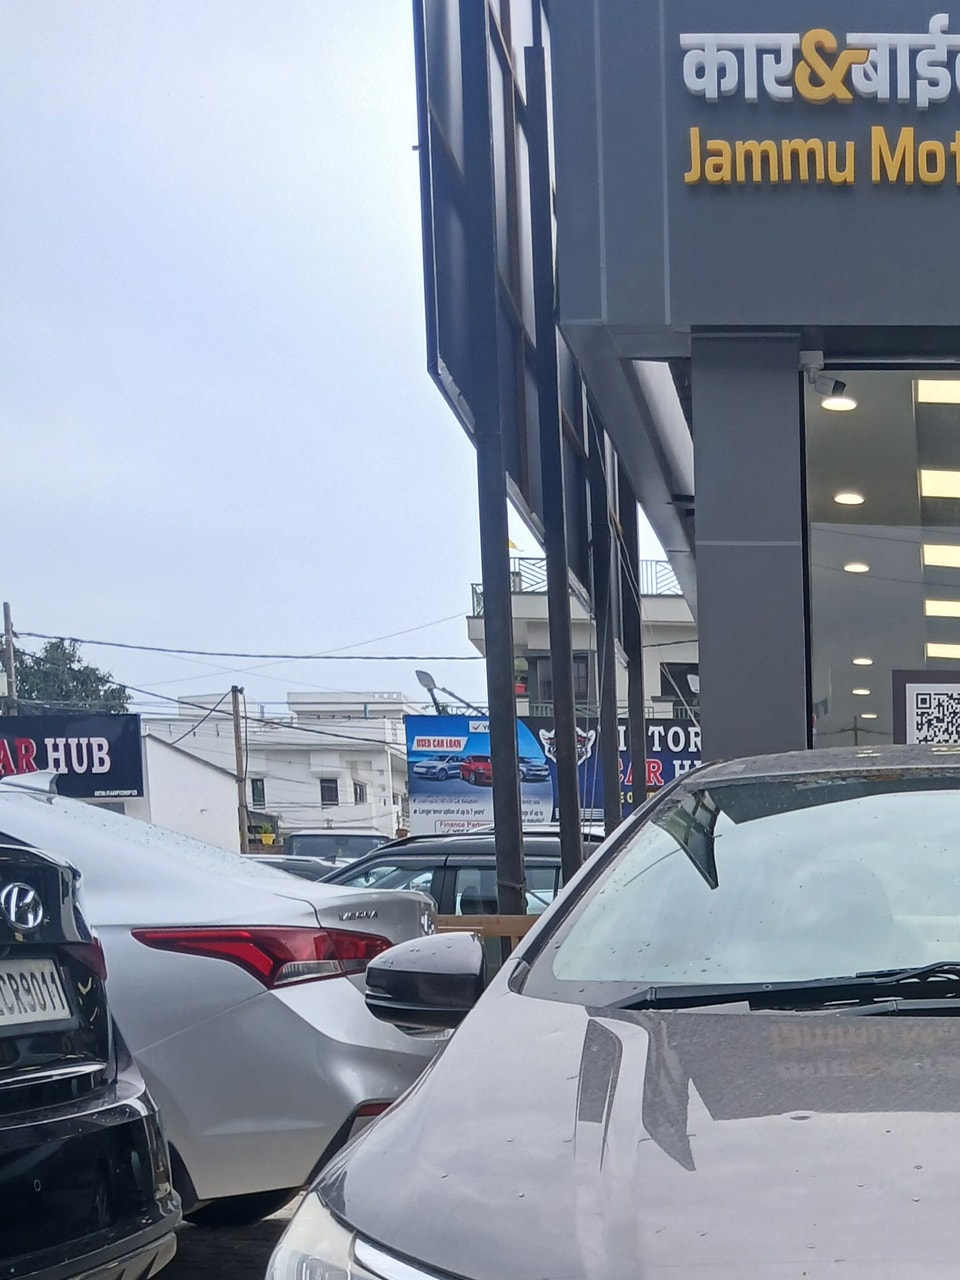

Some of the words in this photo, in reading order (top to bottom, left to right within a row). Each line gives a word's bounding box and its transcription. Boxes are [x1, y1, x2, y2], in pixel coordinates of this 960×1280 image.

[683, 126, 856, 187] Jammu
[44, 737, 111, 774] HUB
[416, 738, 431, 748] USED
[432, 738, 445, 748] CAR
[446, 739, 462, 749] LOAN
[338, 910, 378, 921] VERNA
[0, 971, 66, 1016] CR9011
